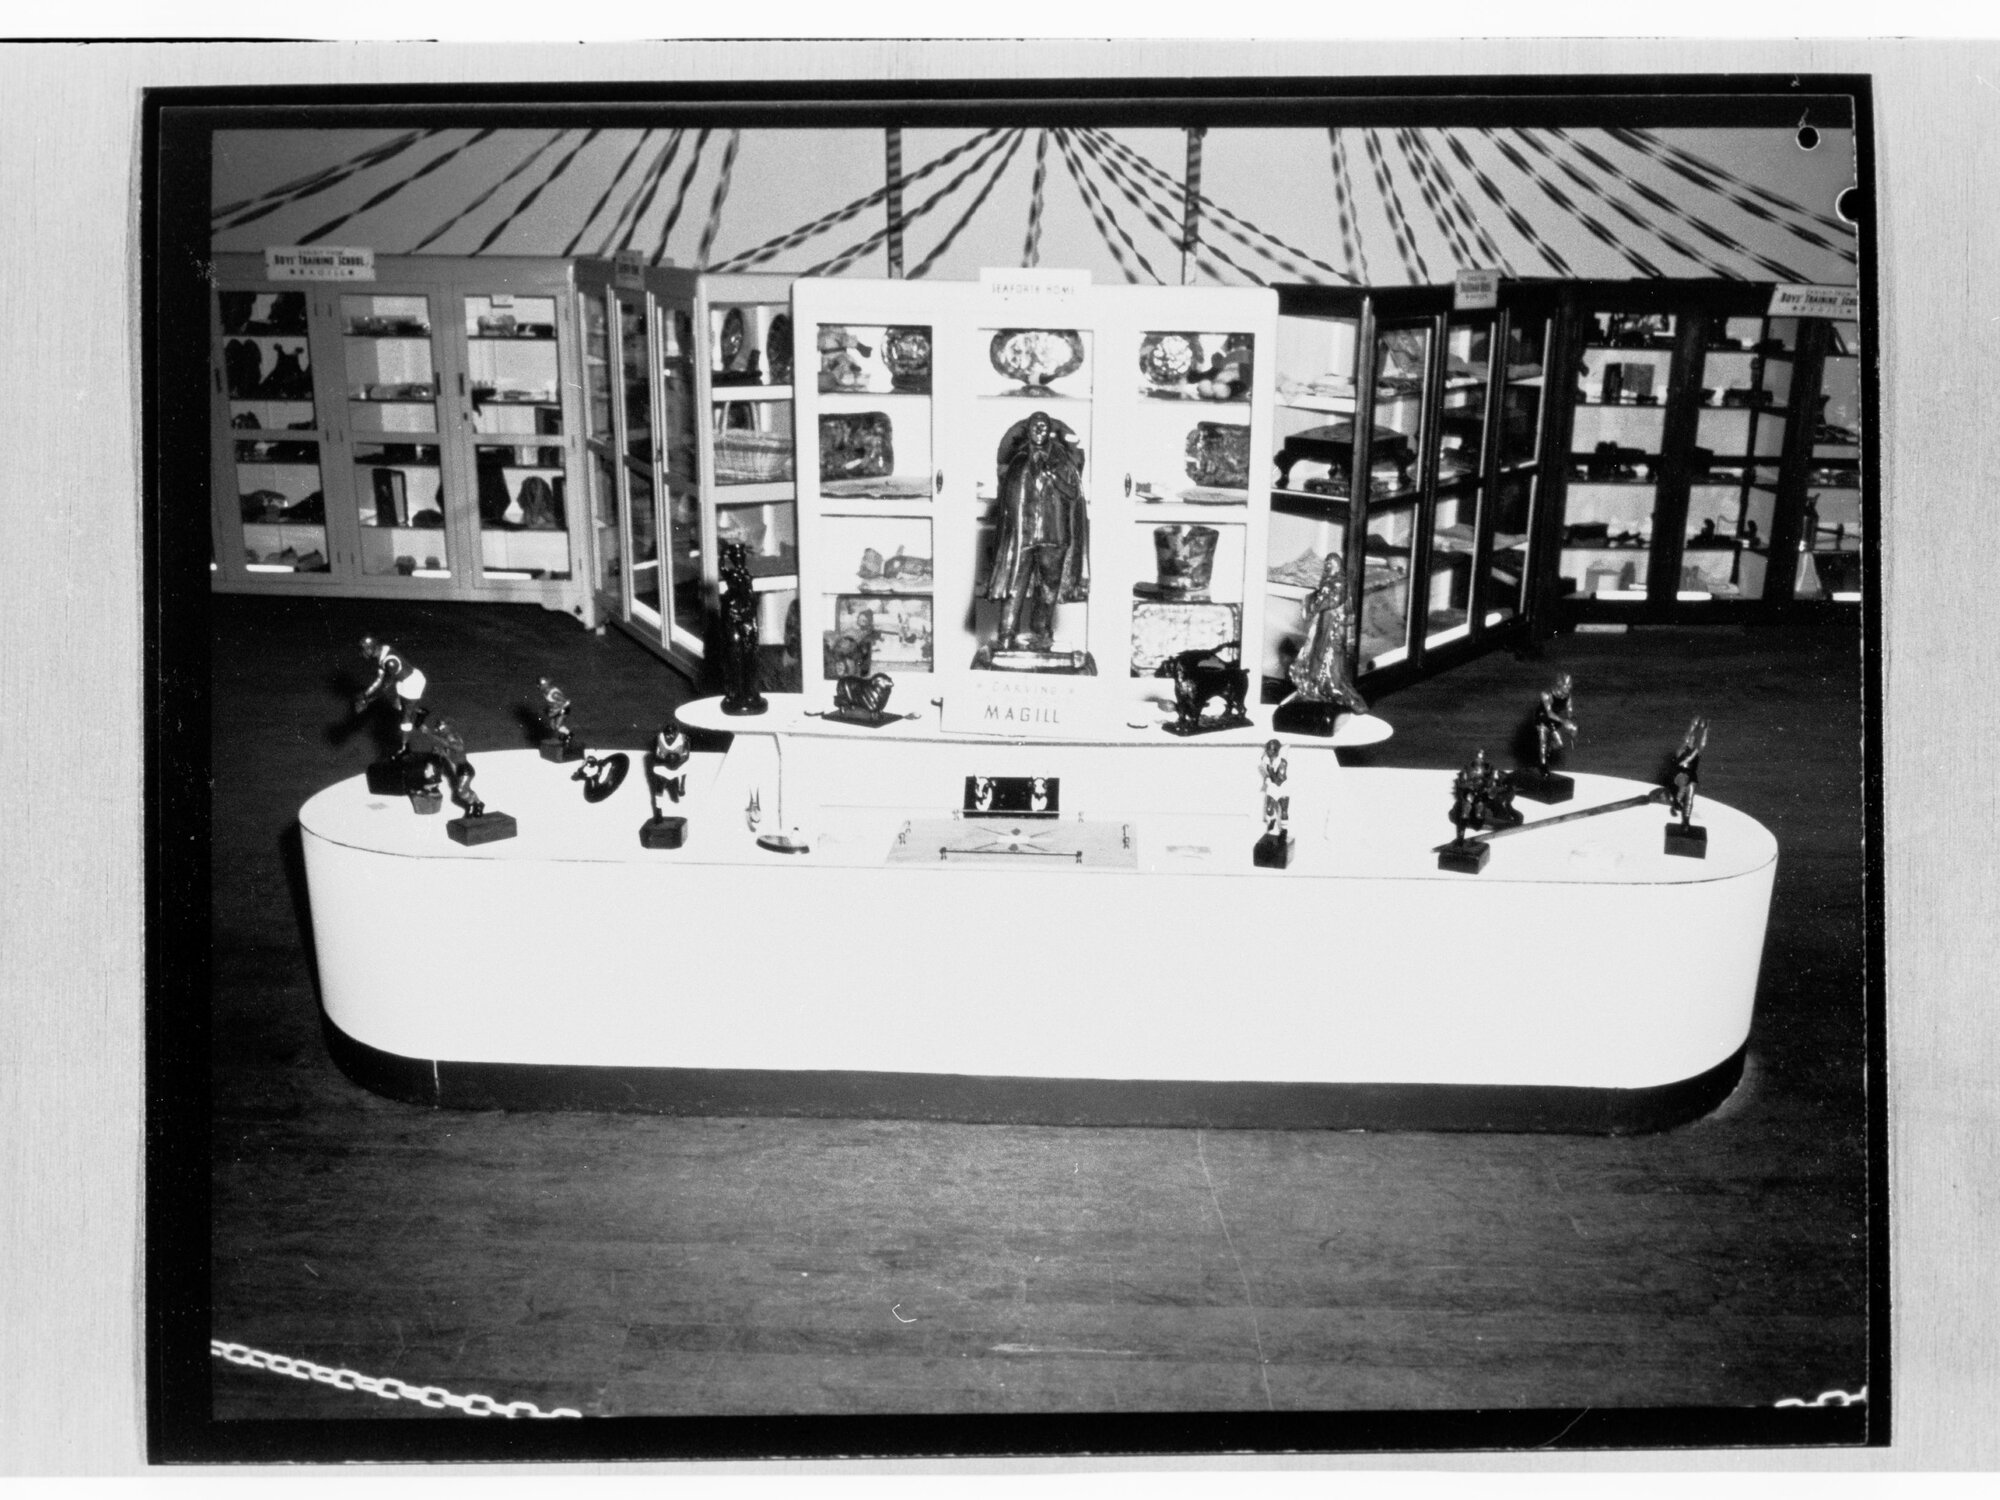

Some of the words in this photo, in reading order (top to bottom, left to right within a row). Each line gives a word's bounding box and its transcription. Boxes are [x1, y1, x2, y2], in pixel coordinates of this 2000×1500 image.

[298, 254, 334, 266] TRAINING
[339, 255, 364, 267] SCHOOL
[984, 703, 1060, 724] MAGILL
